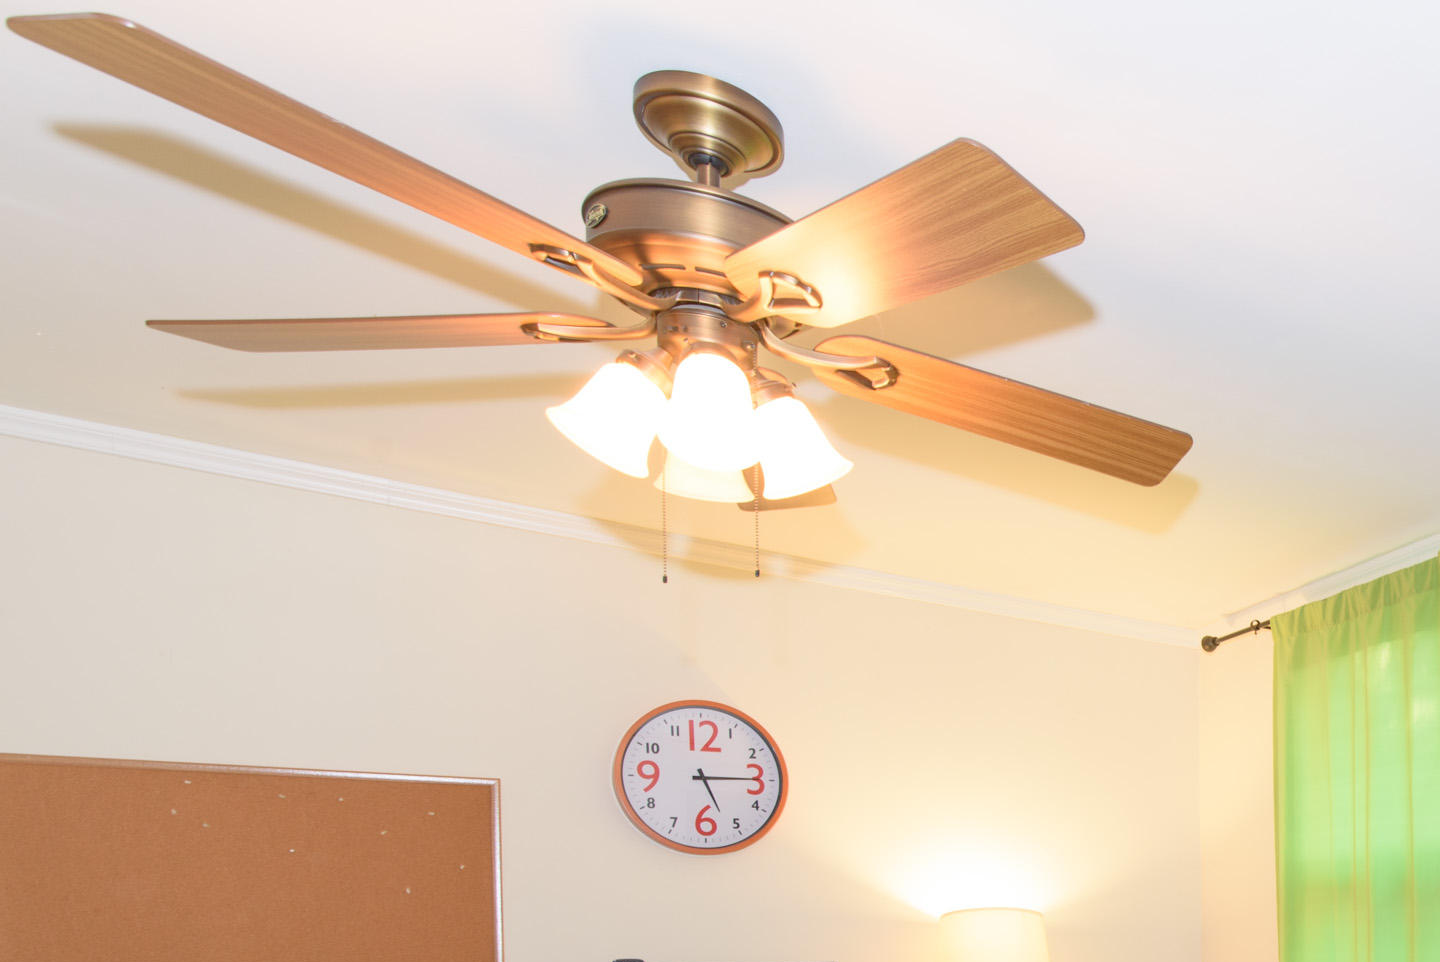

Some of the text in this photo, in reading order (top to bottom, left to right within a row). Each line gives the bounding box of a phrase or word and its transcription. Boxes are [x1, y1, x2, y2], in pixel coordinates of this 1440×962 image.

[671, 725, 679, 736] 11
[688, 720, 722, 752] 12
[728, 728, 732, 739] 1
[646, 743, 660, 754] 10
[748, 748, 756, 759] 2
[637, 760, 660, 792] 9
[746, 763, 765, 795] 3
[647, 798, 655, 808] 8
[752, 800, 759, 810] 4
[670, 817, 678, 828] 7
[695, 805, 717, 836] 6
[733, 818, 740, 829] 5
